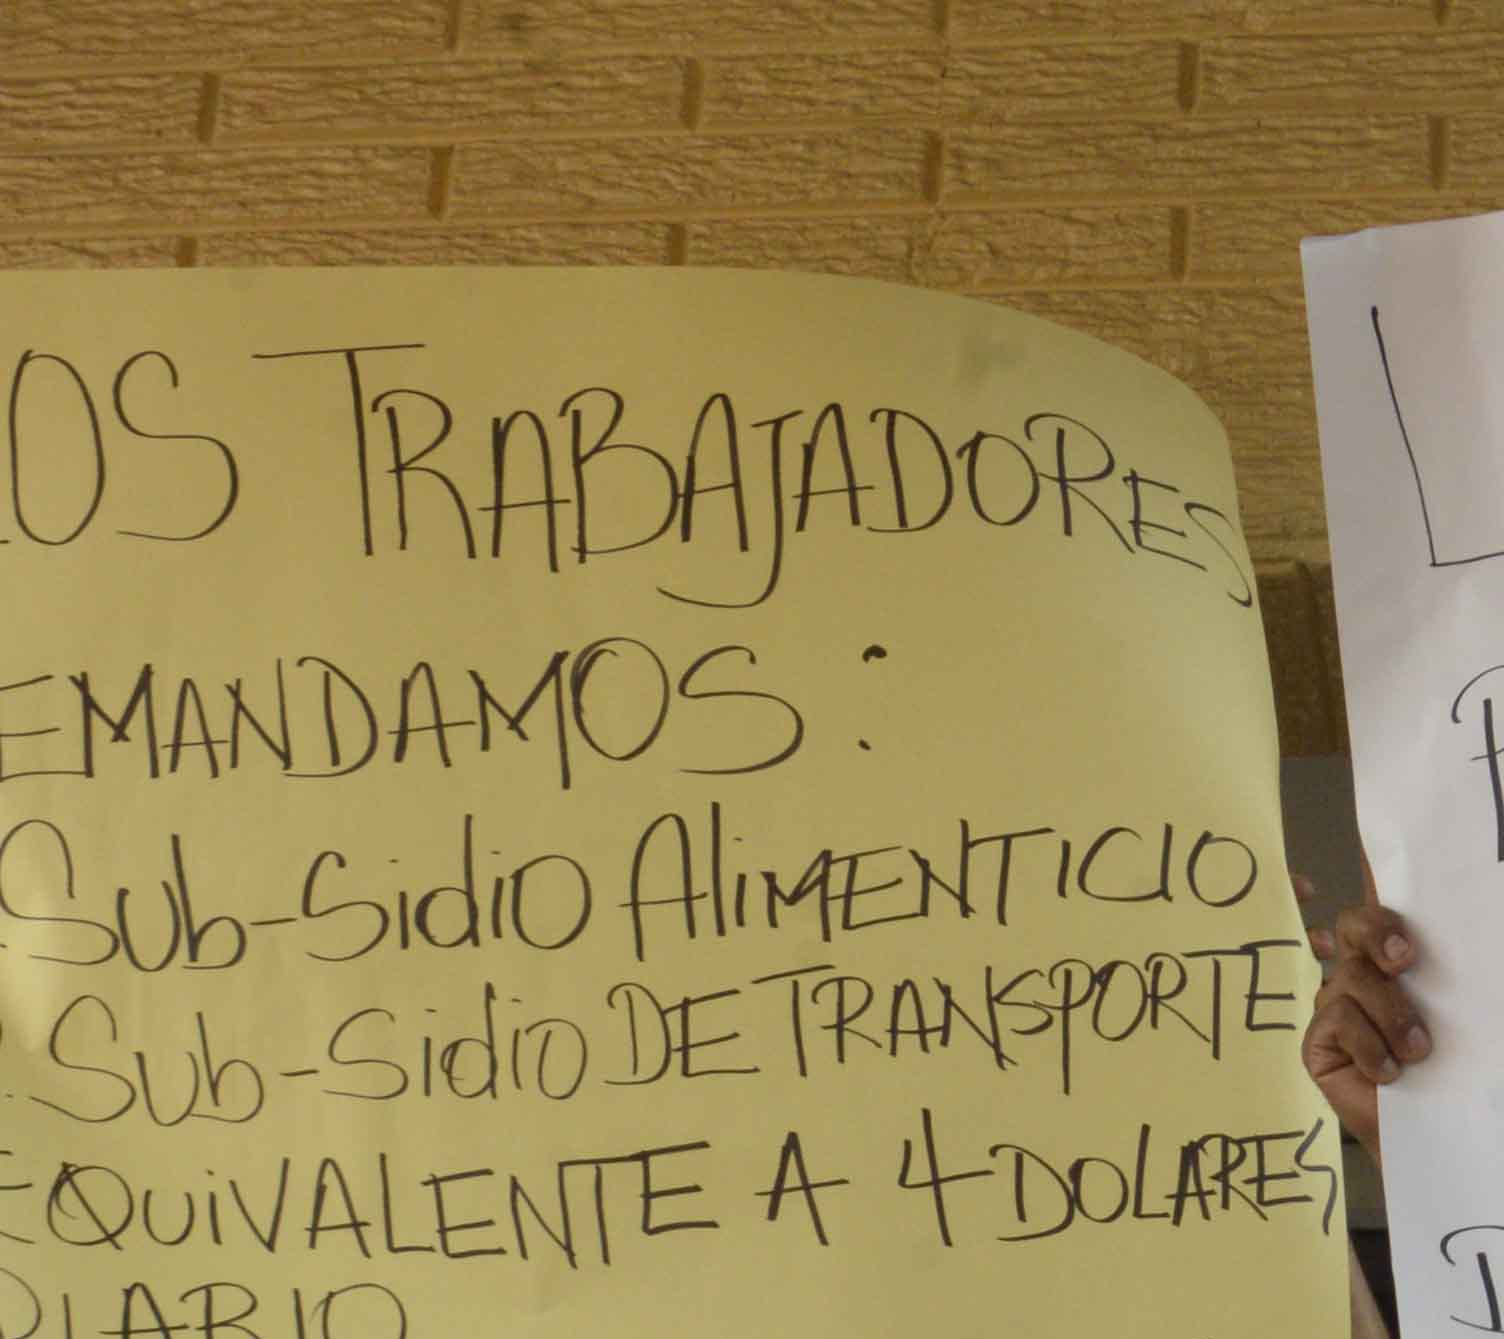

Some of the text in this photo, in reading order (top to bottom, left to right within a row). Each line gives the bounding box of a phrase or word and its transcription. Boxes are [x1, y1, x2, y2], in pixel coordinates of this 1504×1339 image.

[252, 343, 1253, 608] TRABAJADORES
[603, 981, 761, 1086] DE
[751, 938, 1302, 1096] TRANSPORTE
[756, 1130, 849, 1246] A
[897, 1110, 993, 1248] 4
[985, 1116, 1338, 1242] DOLARES
